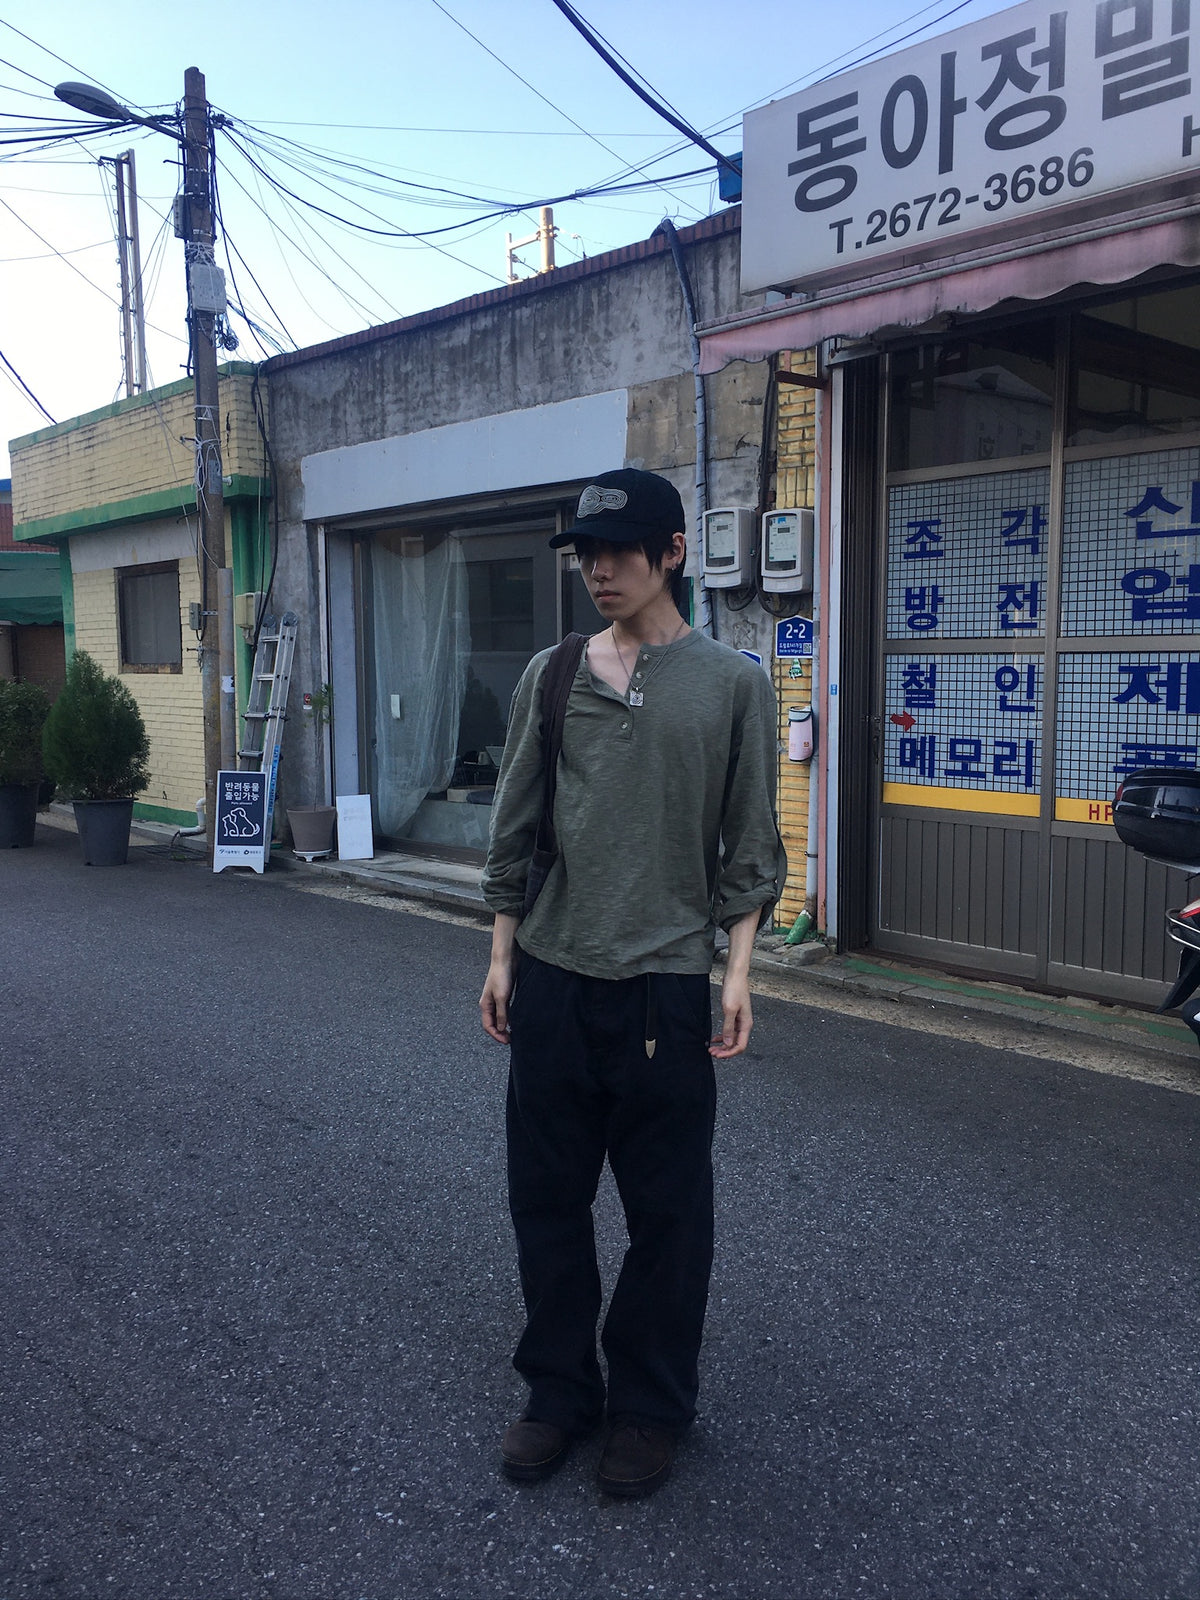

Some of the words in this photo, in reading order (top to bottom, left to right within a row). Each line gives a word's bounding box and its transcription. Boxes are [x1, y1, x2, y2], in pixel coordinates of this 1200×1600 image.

[787, 0, 1192, 213] 동아정밀
[829, 147, 1095, 254] T.2672-3686
[785, 623, 806, 639] 2-2
[900, 735, 1034, 788] 메모리
[225, 782, 259, 792] 반려동물
[225, 791, 259, 801] 출입가능
